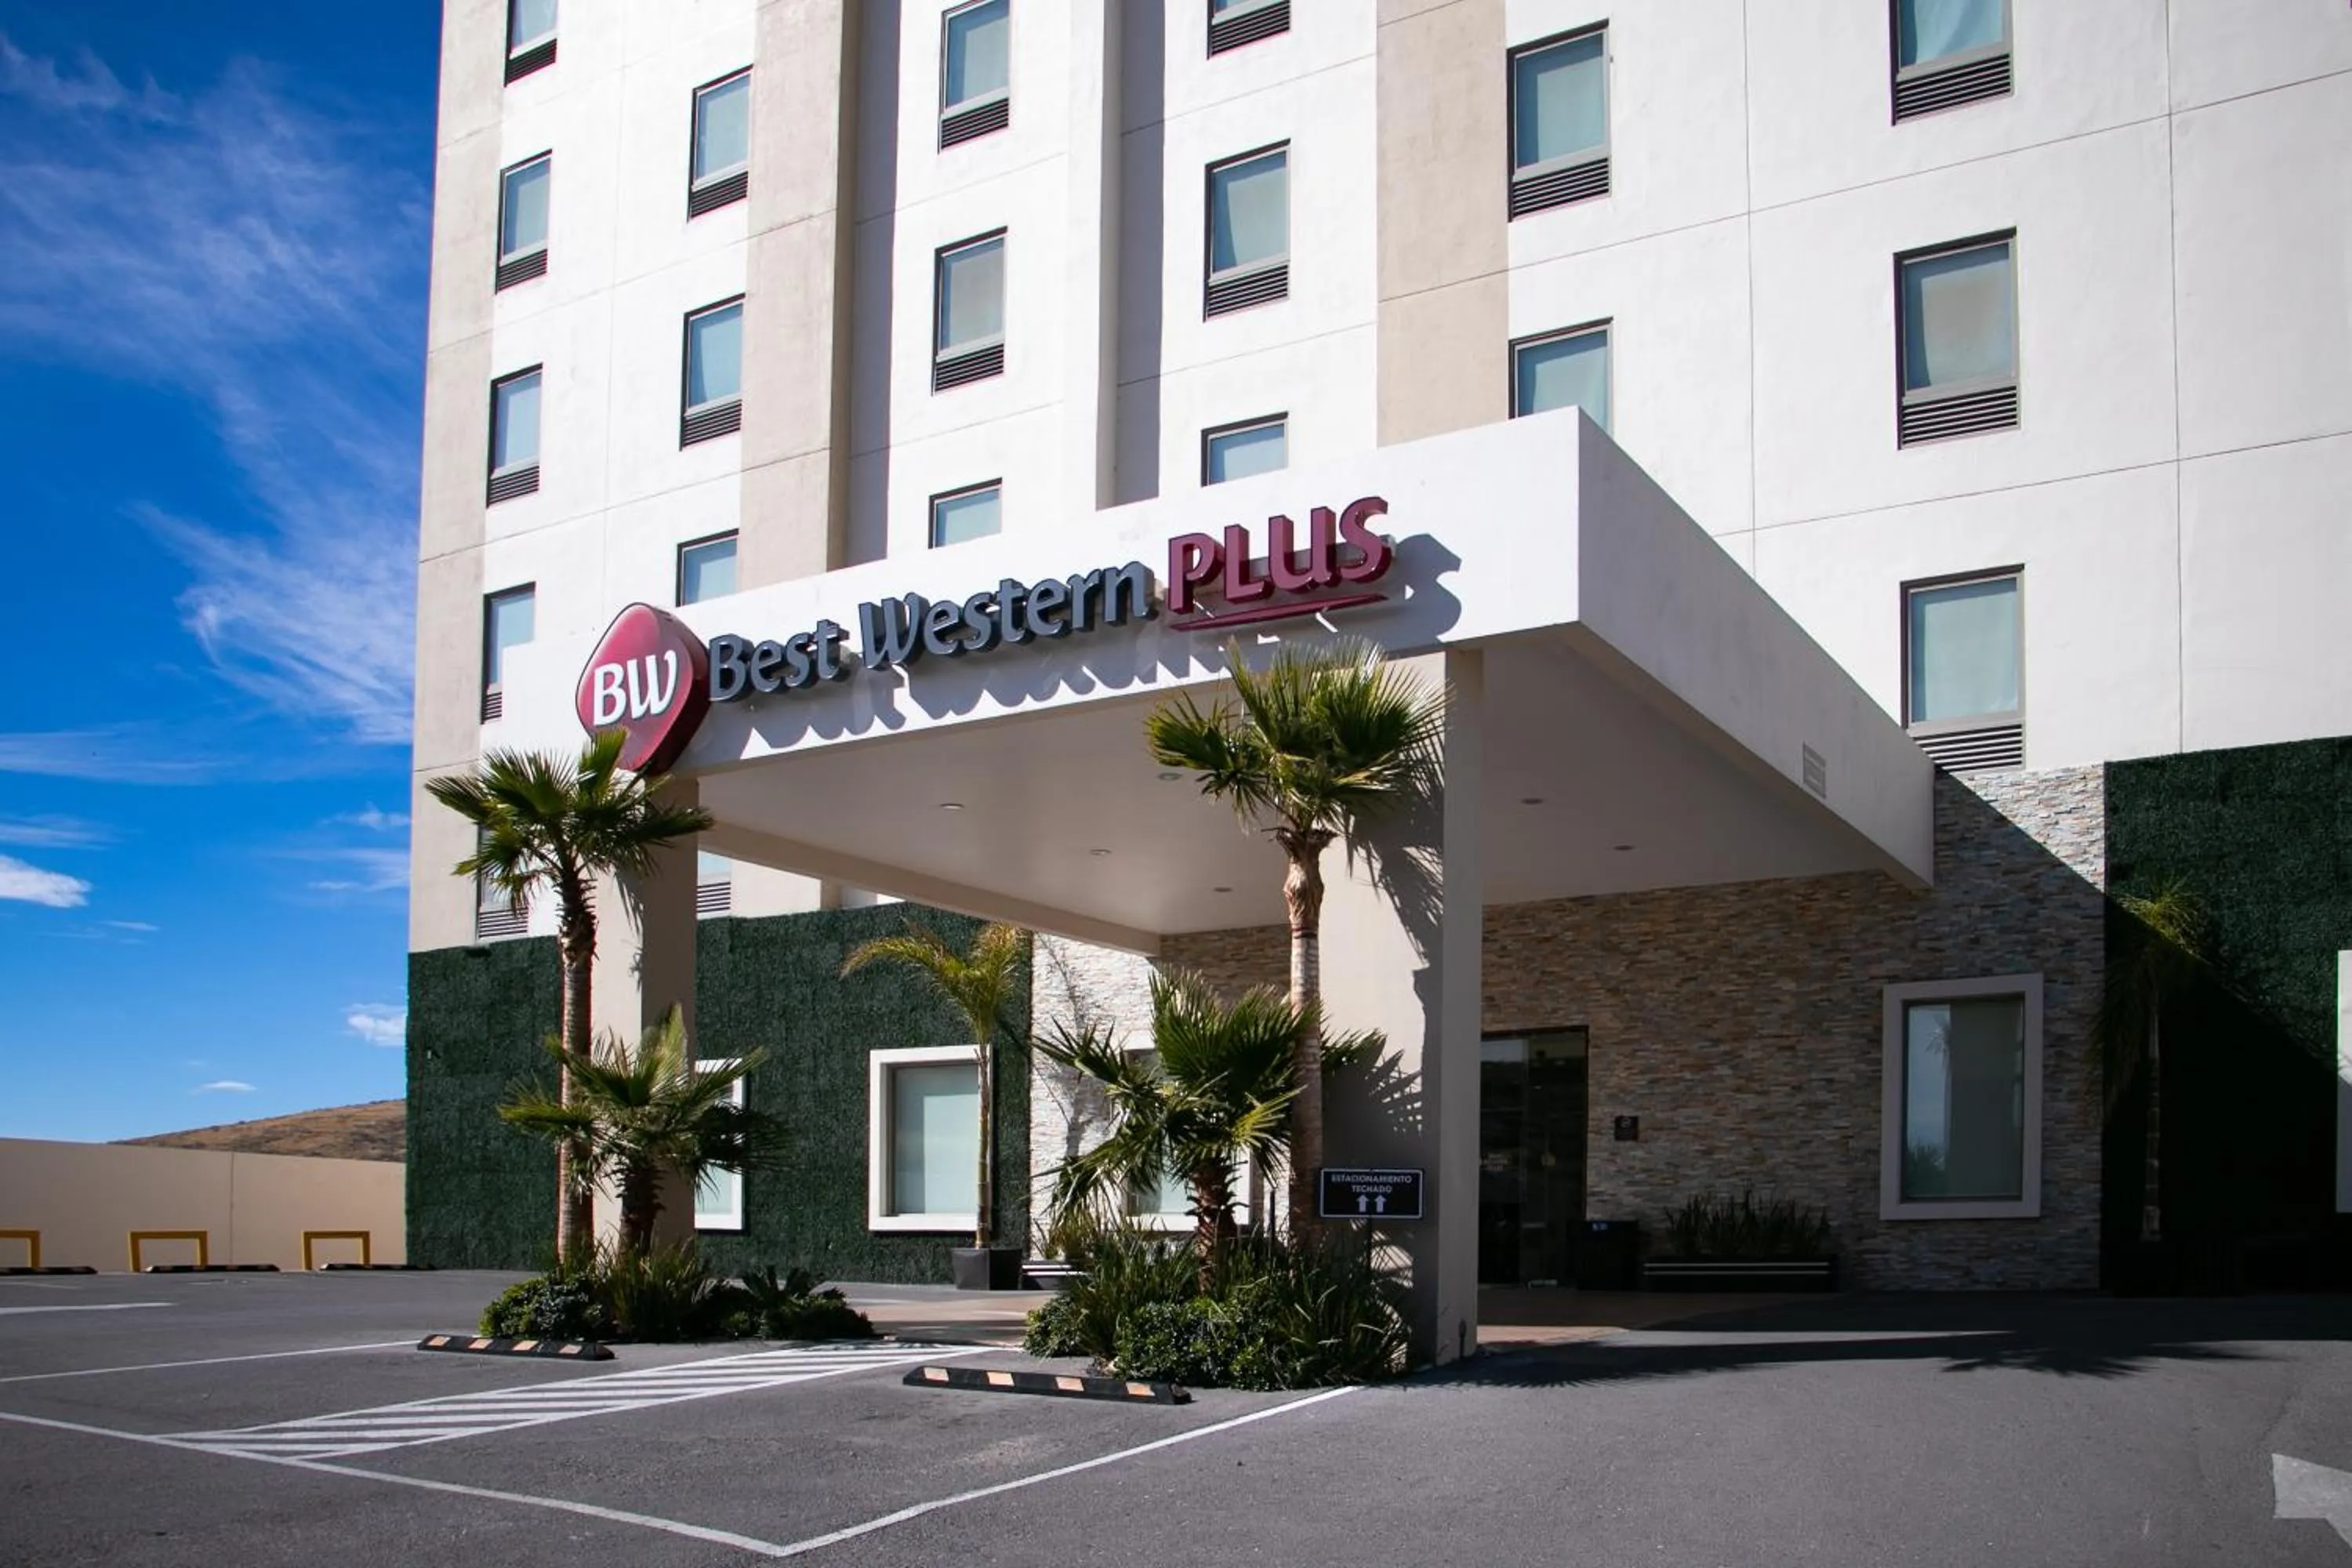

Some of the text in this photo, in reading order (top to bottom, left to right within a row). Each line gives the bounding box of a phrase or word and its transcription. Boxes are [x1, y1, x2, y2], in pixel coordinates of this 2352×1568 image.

[709, 495, 1392, 702] Best Western PLUS
[592, 649, 679, 727] BW
[1330, 1174, 1413, 1184] ESTACIONAMIENTO
[1351, 1184, 1393, 1193] TECHADO
